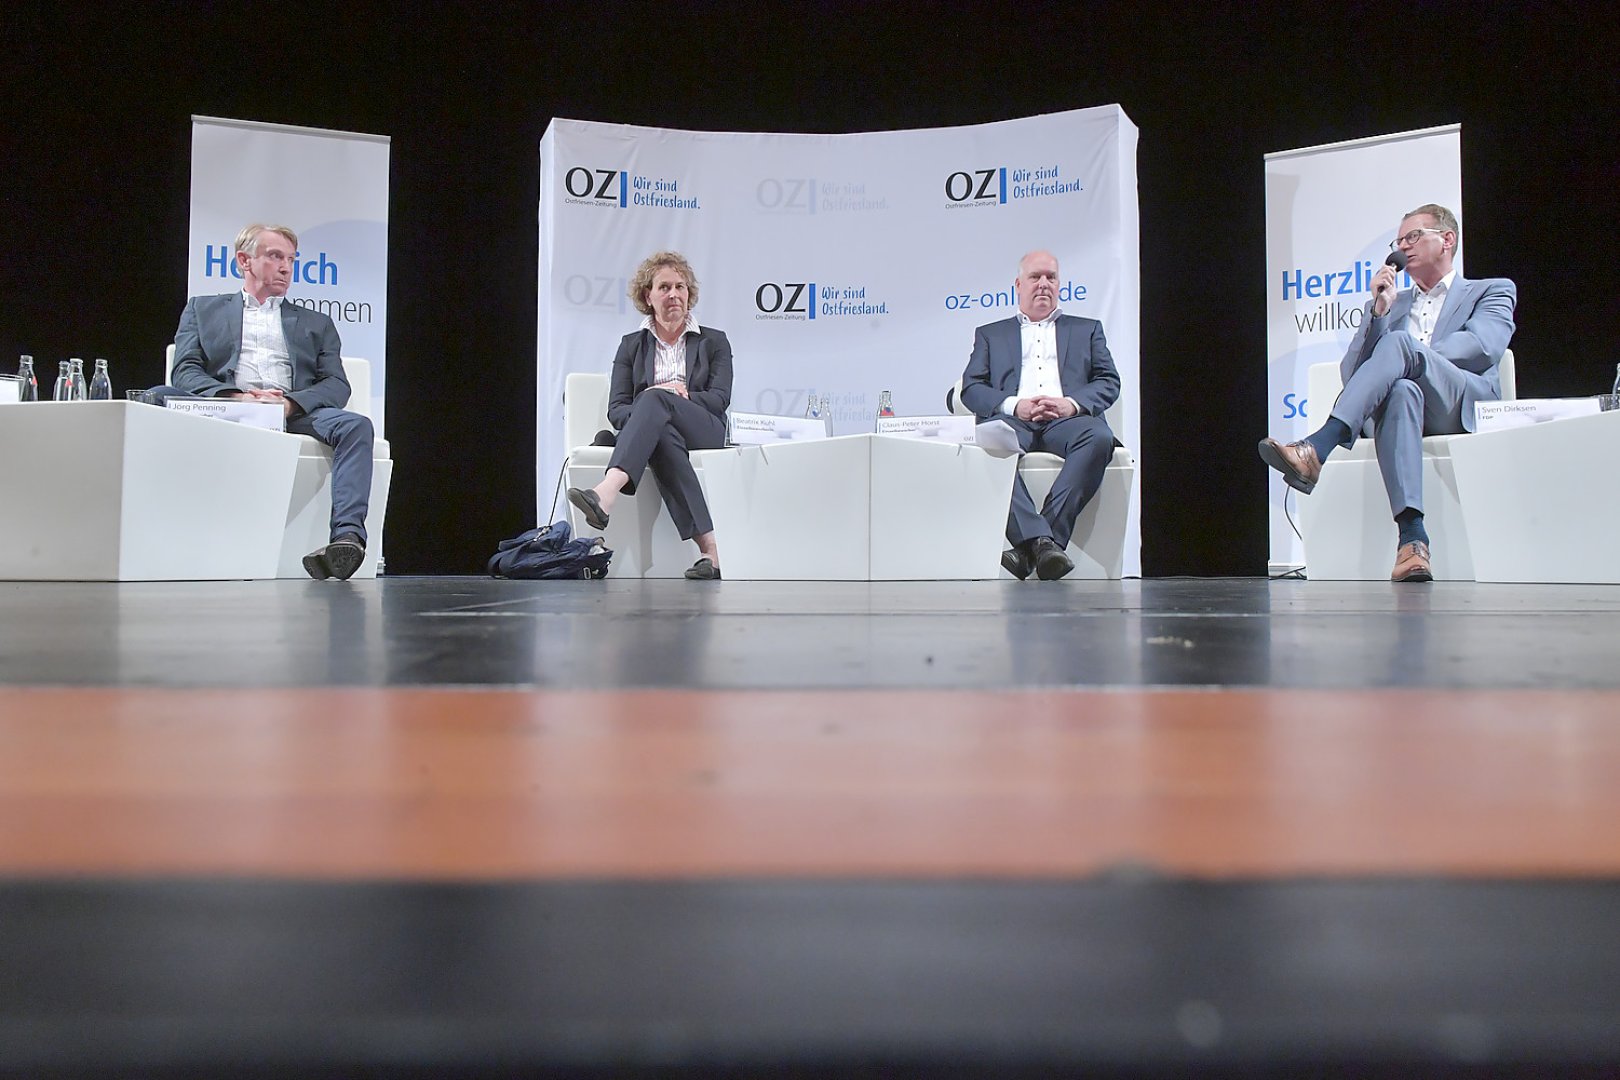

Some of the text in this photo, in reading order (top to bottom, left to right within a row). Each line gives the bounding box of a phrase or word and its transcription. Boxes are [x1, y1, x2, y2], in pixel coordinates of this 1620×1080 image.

[565, 166, 618, 200] OZ
[633, 176, 677, 193] Wir sind
[945, 168, 997, 202] OZ
[1013, 165, 1058, 183] Wir sind
[633, 192, 701, 210] Ostfriesland.
[756, 178, 806, 209] OZ
[1013, 180, 1084, 199] Ostfriesland.
[205, 245, 338, 285] Hich
[564, 274, 617, 307] OZ
[821, 286, 865, 300] Wir sind
[1282, 260, 1411, 301] Herzli
[755, 283, 806, 313] OZ
[822, 301, 889, 317] Ostfriesland.
[944, 282, 1087, 310] oz-onlde
[1294, 302, 1363, 334] willko
[192, 403, 227, 413] Penning
